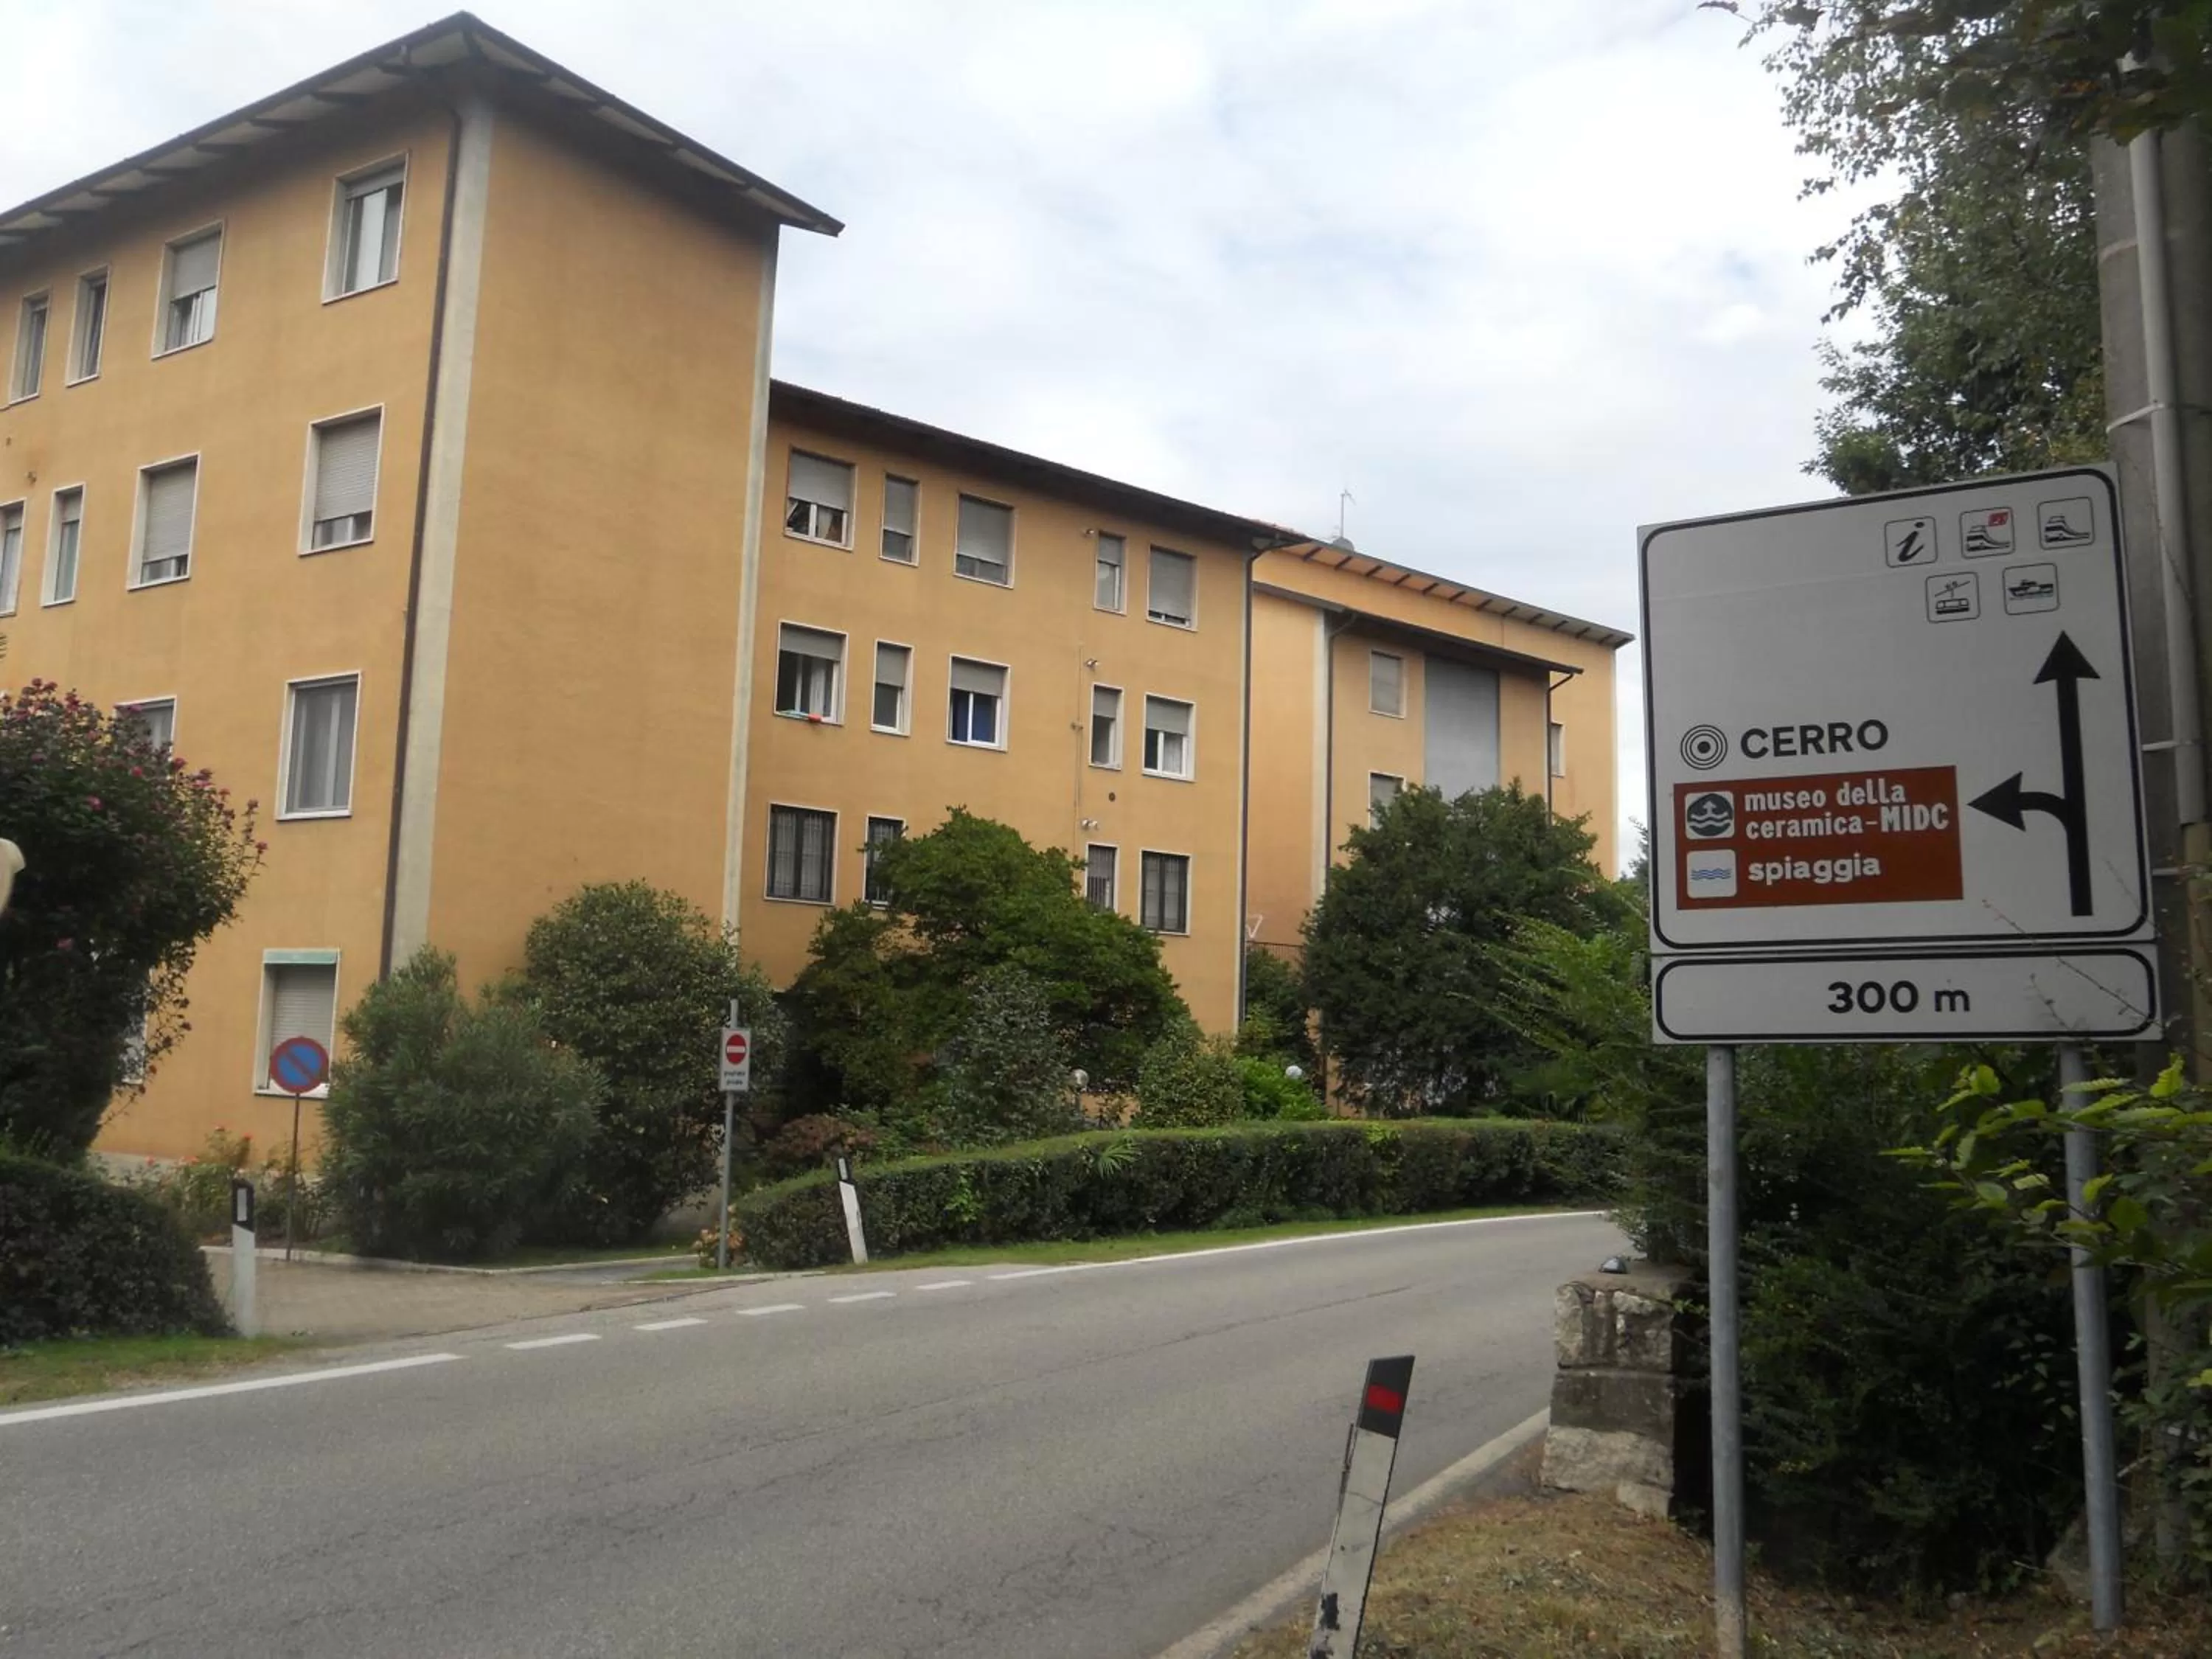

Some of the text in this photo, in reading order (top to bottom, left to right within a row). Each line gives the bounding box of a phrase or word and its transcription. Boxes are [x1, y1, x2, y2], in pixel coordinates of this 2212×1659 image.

[1741, 719, 1889, 759] CERRO
[1745, 778, 1906, 811] museo della
[1745, 802, 1949, 839] ceramica-MIDC
[1747, 851, 1881, 885] spiaggia
[1828, 980, 1971, 1014] 300 m
